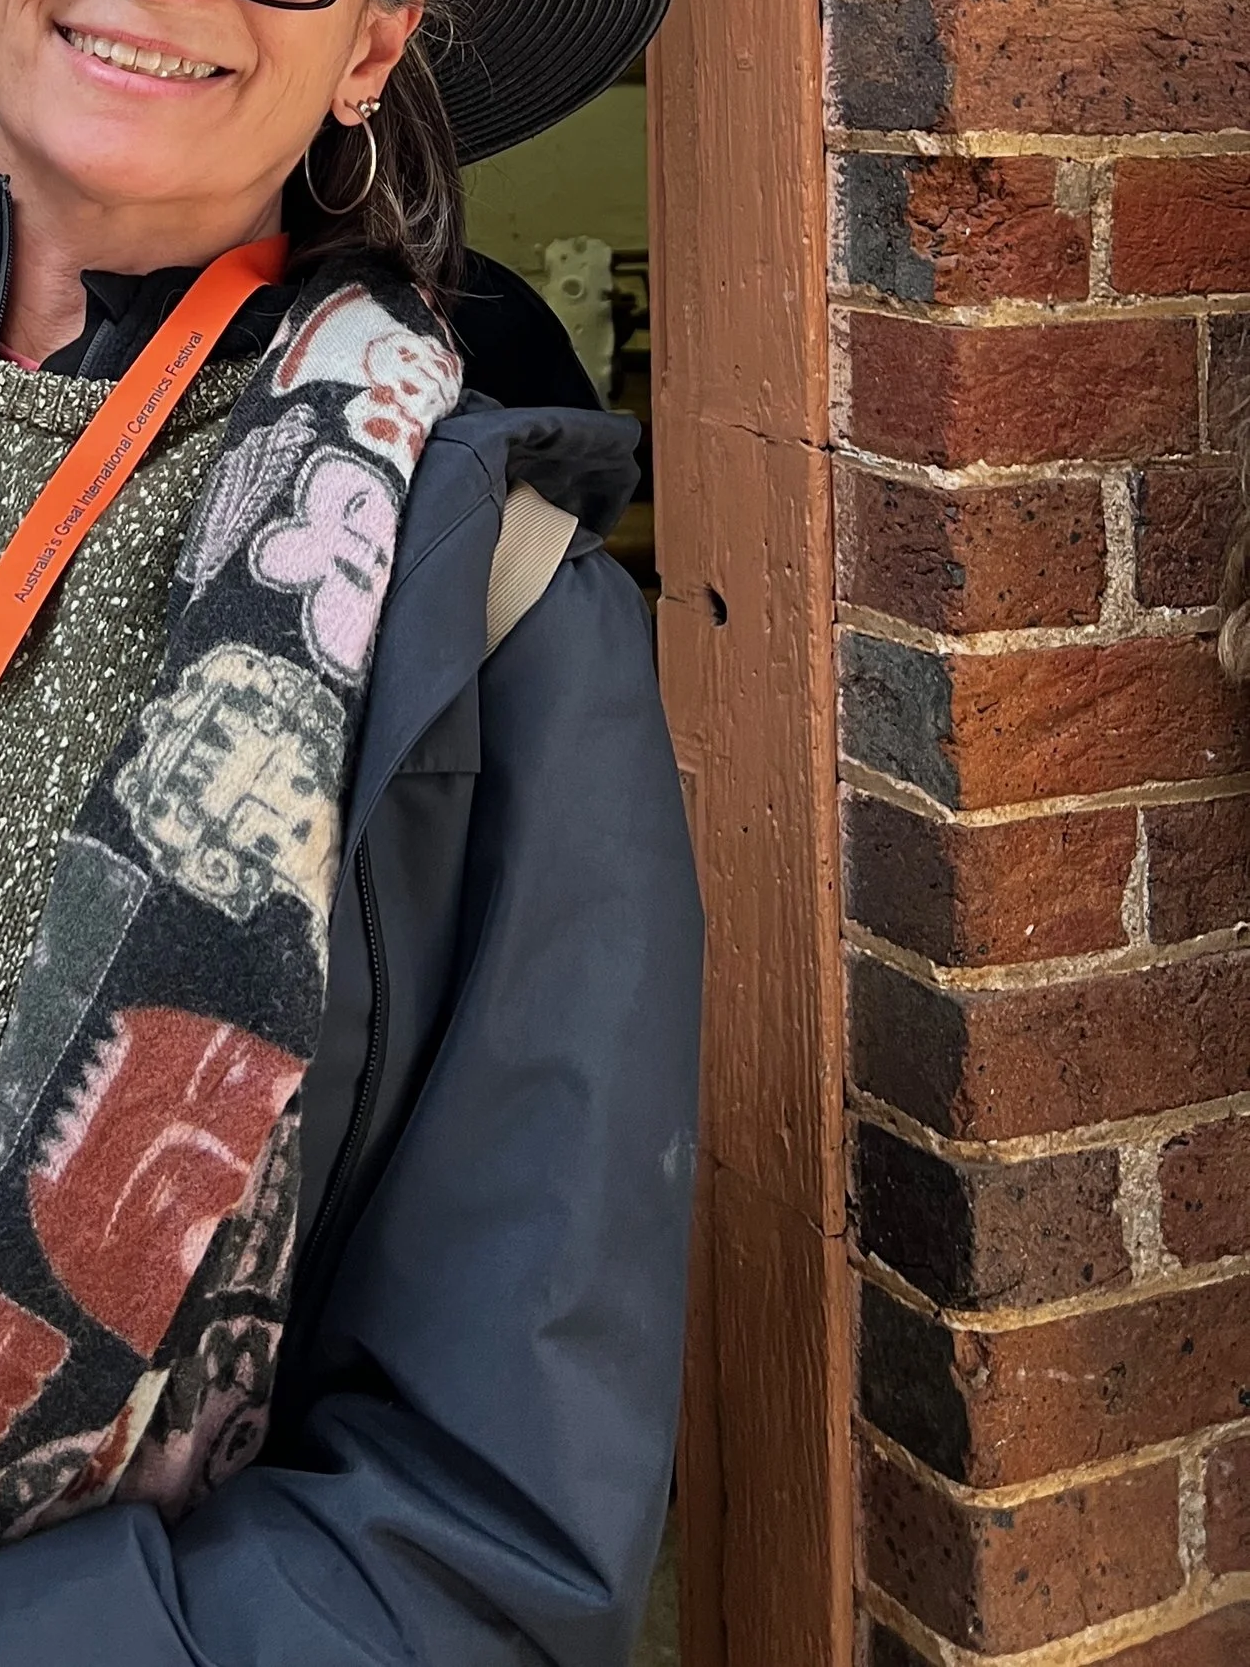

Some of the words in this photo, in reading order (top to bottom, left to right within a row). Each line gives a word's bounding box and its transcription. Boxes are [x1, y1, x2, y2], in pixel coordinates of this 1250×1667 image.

[14, 536, 62, 603] Australia's
[54, 505, 83, 536] Great
[79, 433, 134, 515] International
[127, 376, 173, 435] Ceramics
[165, 331, 204, 378] Festival
